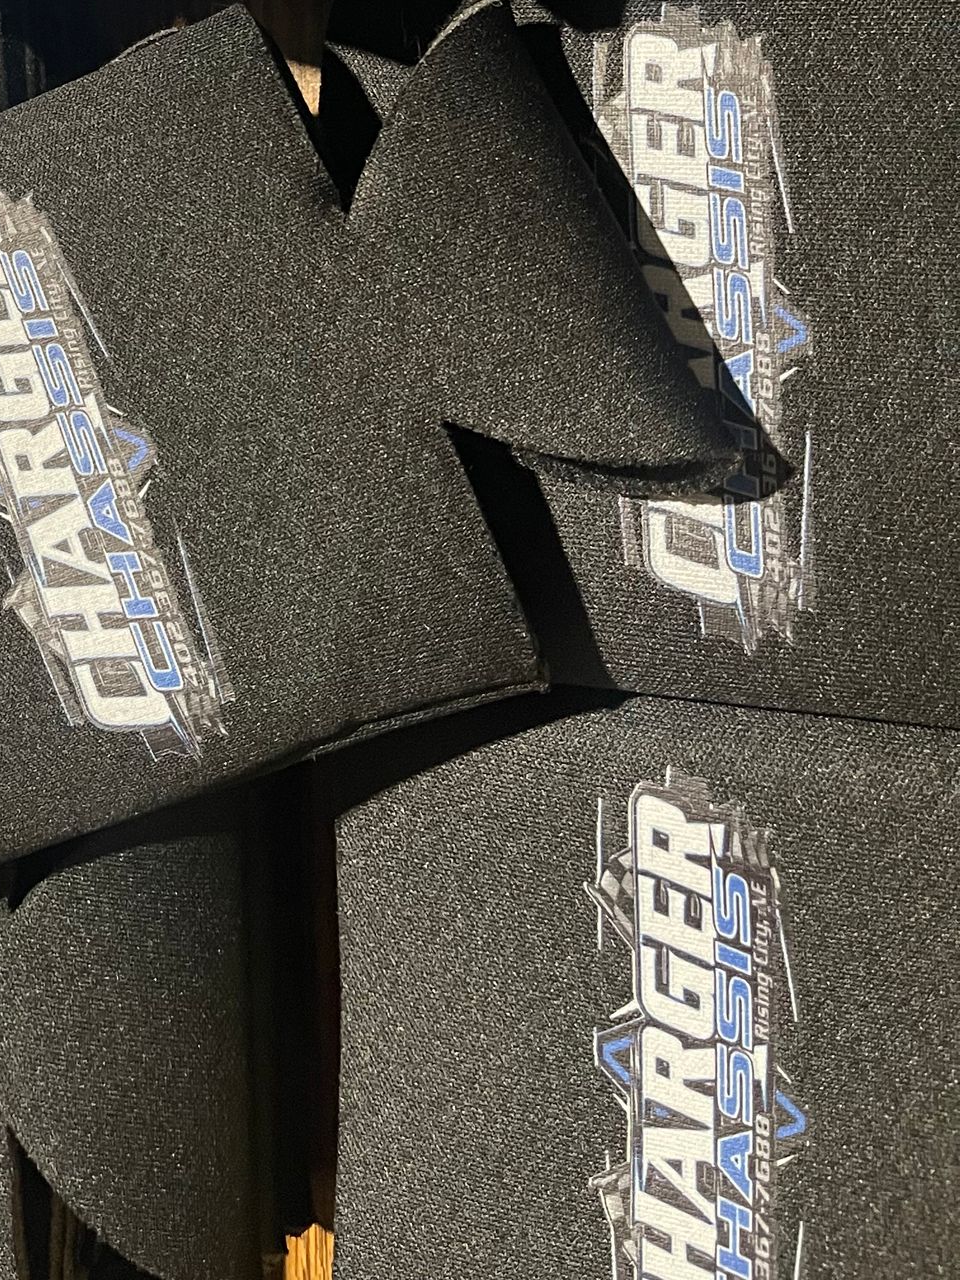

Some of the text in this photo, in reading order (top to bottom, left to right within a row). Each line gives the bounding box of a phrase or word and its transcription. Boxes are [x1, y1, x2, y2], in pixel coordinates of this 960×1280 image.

[629, 33, 737, 602] CRGER
[746, 187, 768, 257] Rising
[0, 249, 184, 693] CHASSIS
[62, 328, 91, 389] Rising
[750, 879, 769, 912] NE
[751, 971, 775, 1042] Rising
[637, 795, 727, 1280] HARGER
[712, 863, 755, 1280] HASSIS
